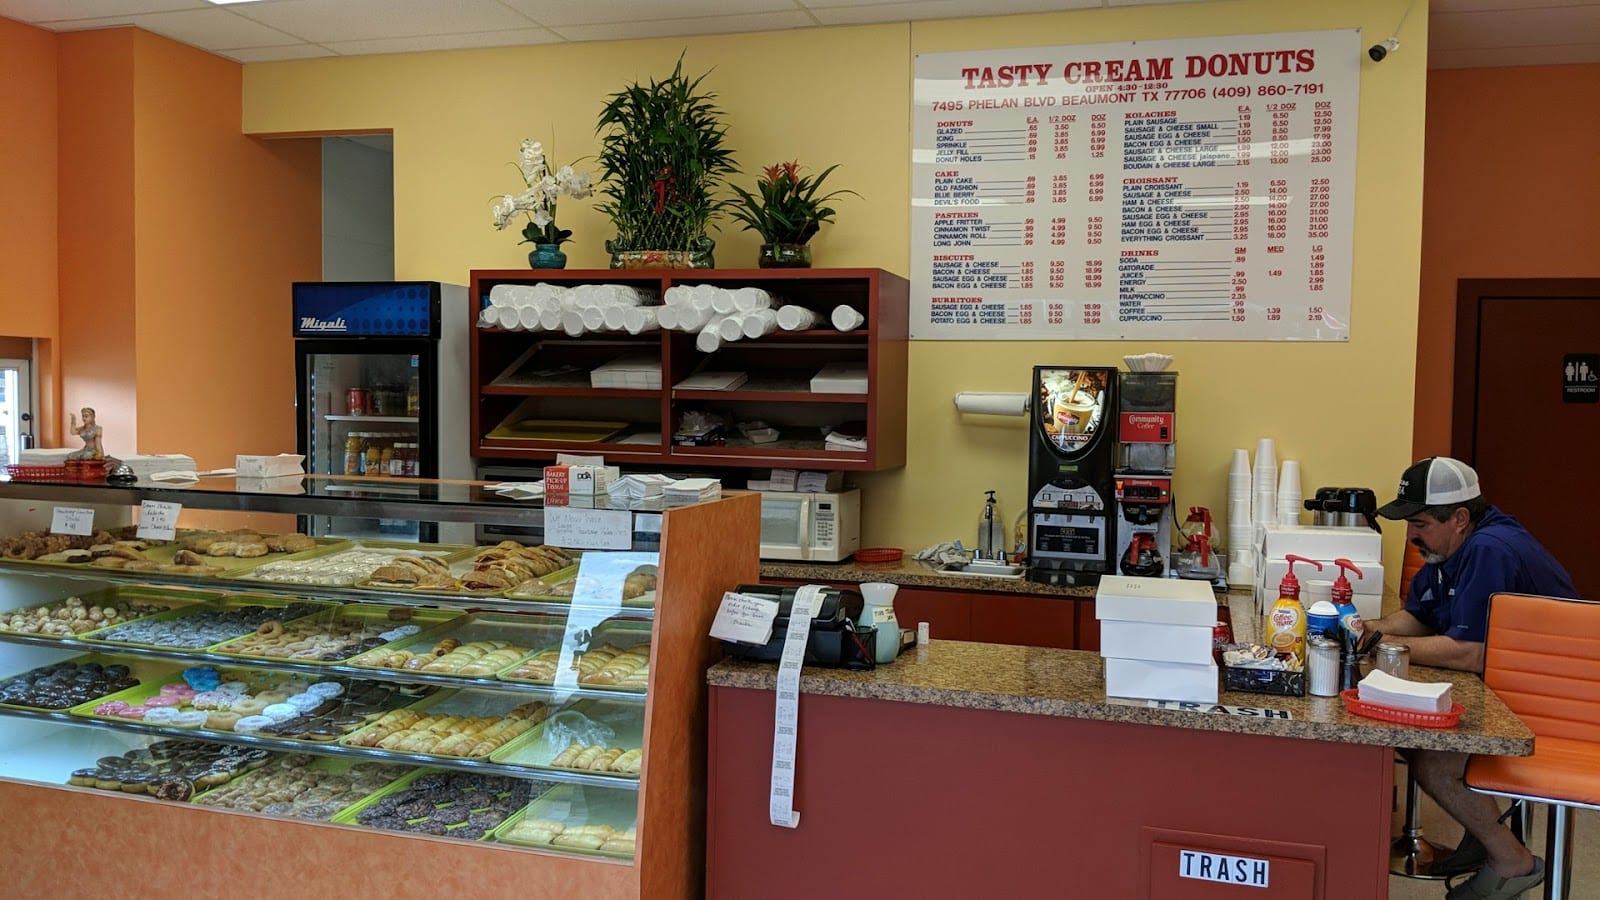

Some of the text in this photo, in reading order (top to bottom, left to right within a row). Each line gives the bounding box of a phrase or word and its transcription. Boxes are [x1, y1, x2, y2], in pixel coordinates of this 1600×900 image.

[962, 50, 1315, 90] TASTY CREAM DONUTS
[1085, 82, 1168, 93] OPEN 4:30-12:30
[932, 83, 1324, 111] 7495 PHELAN BLVD BEAUMONT TX 77706 (409) 860-7191
[1125, 111, 1176, 119] KOLACHES
[301, 317, 347, 330] Migali
[1129, 415, 1164, 424] Community
[1184, 853, 1265, 884] TRASH
